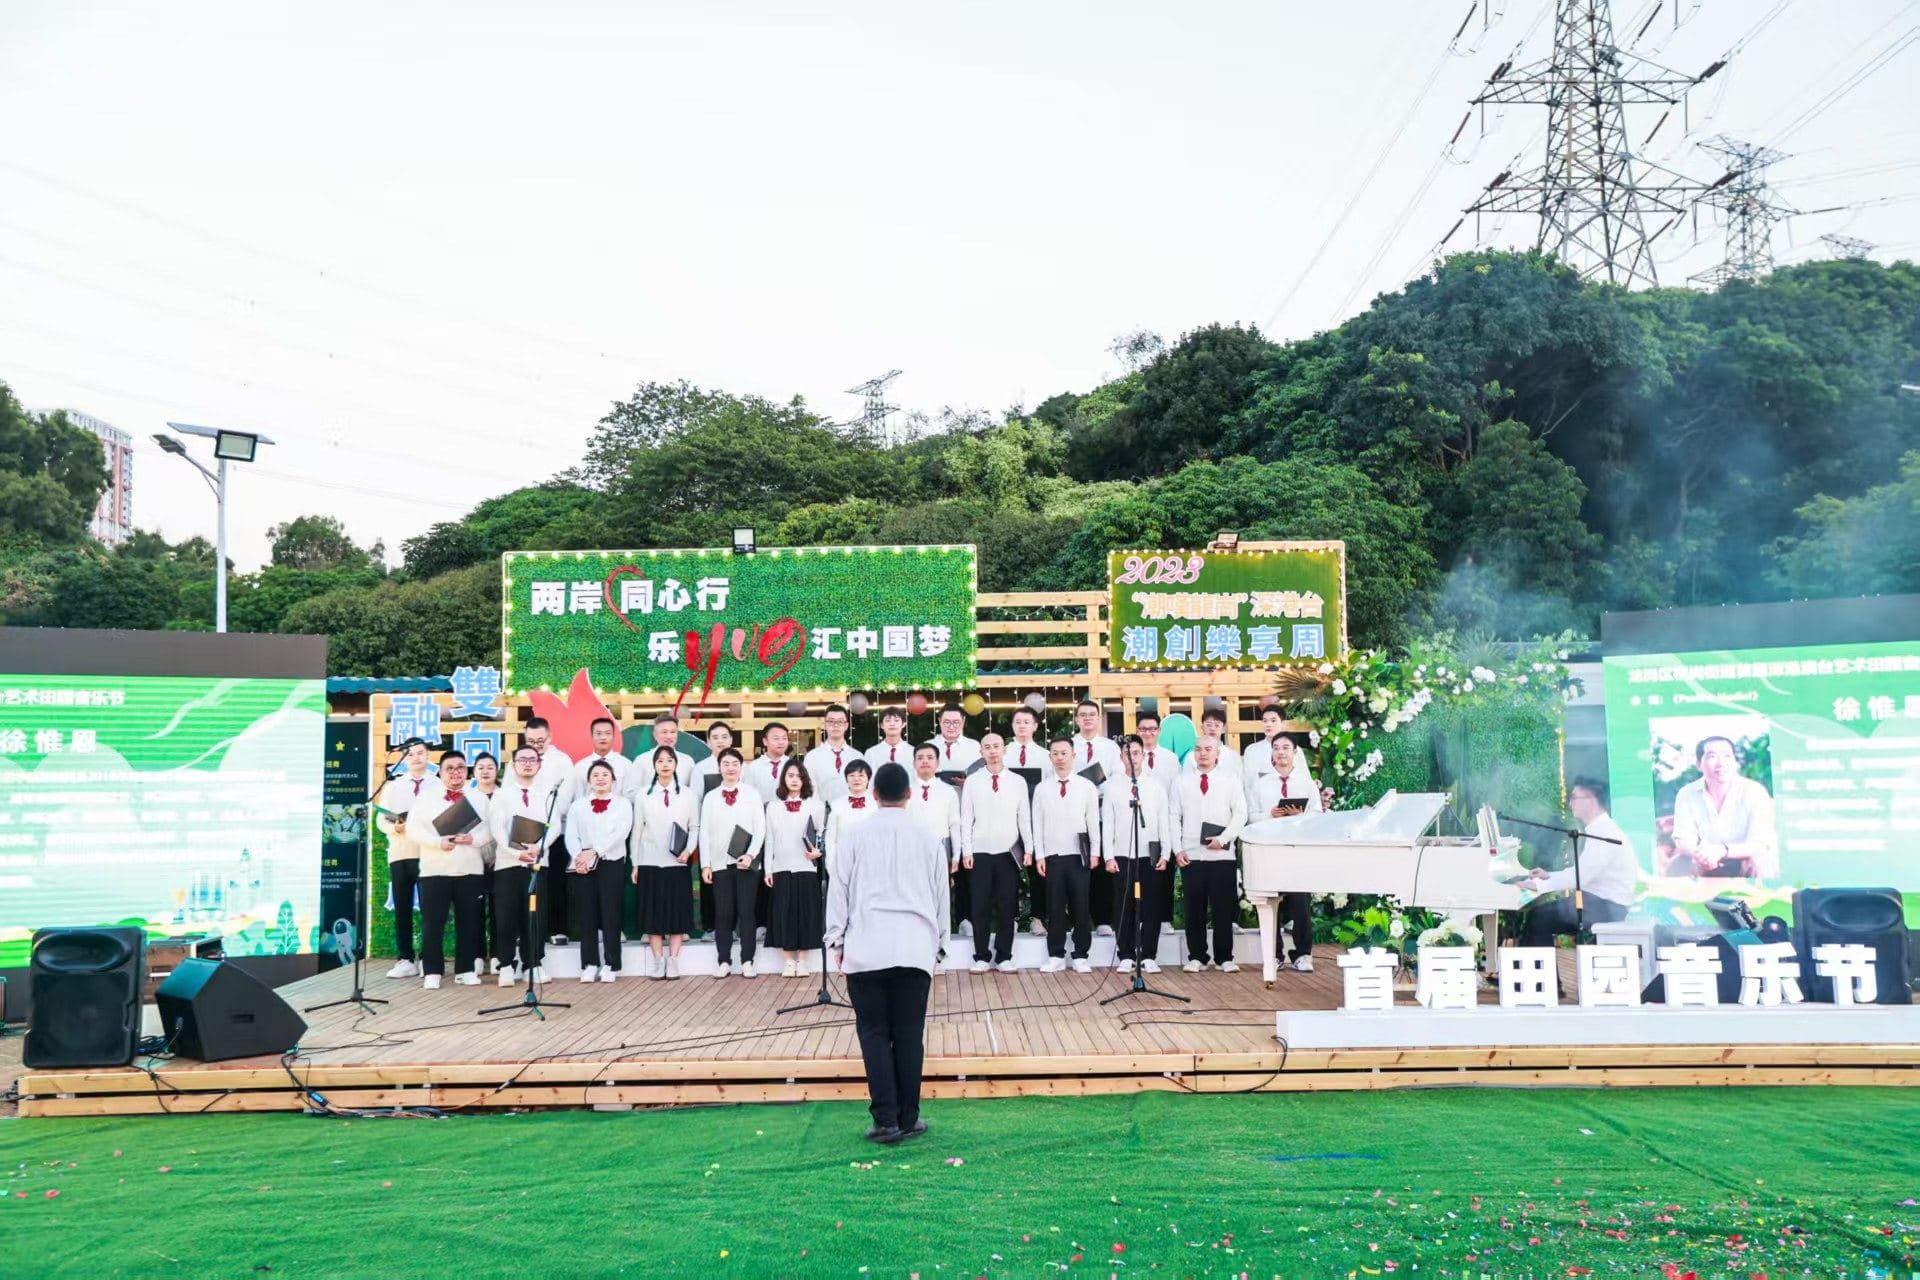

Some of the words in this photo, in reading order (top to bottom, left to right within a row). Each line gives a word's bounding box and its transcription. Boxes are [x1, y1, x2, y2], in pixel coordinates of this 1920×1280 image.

[1115, 555, 1205, 585] 2023
[1122, 625, 1325, 662] 潮創樂享周
[0, 690, 125, 709] 艺术田音乐节
[1337, 942, 1879, 1008] 首届田园音乐节
